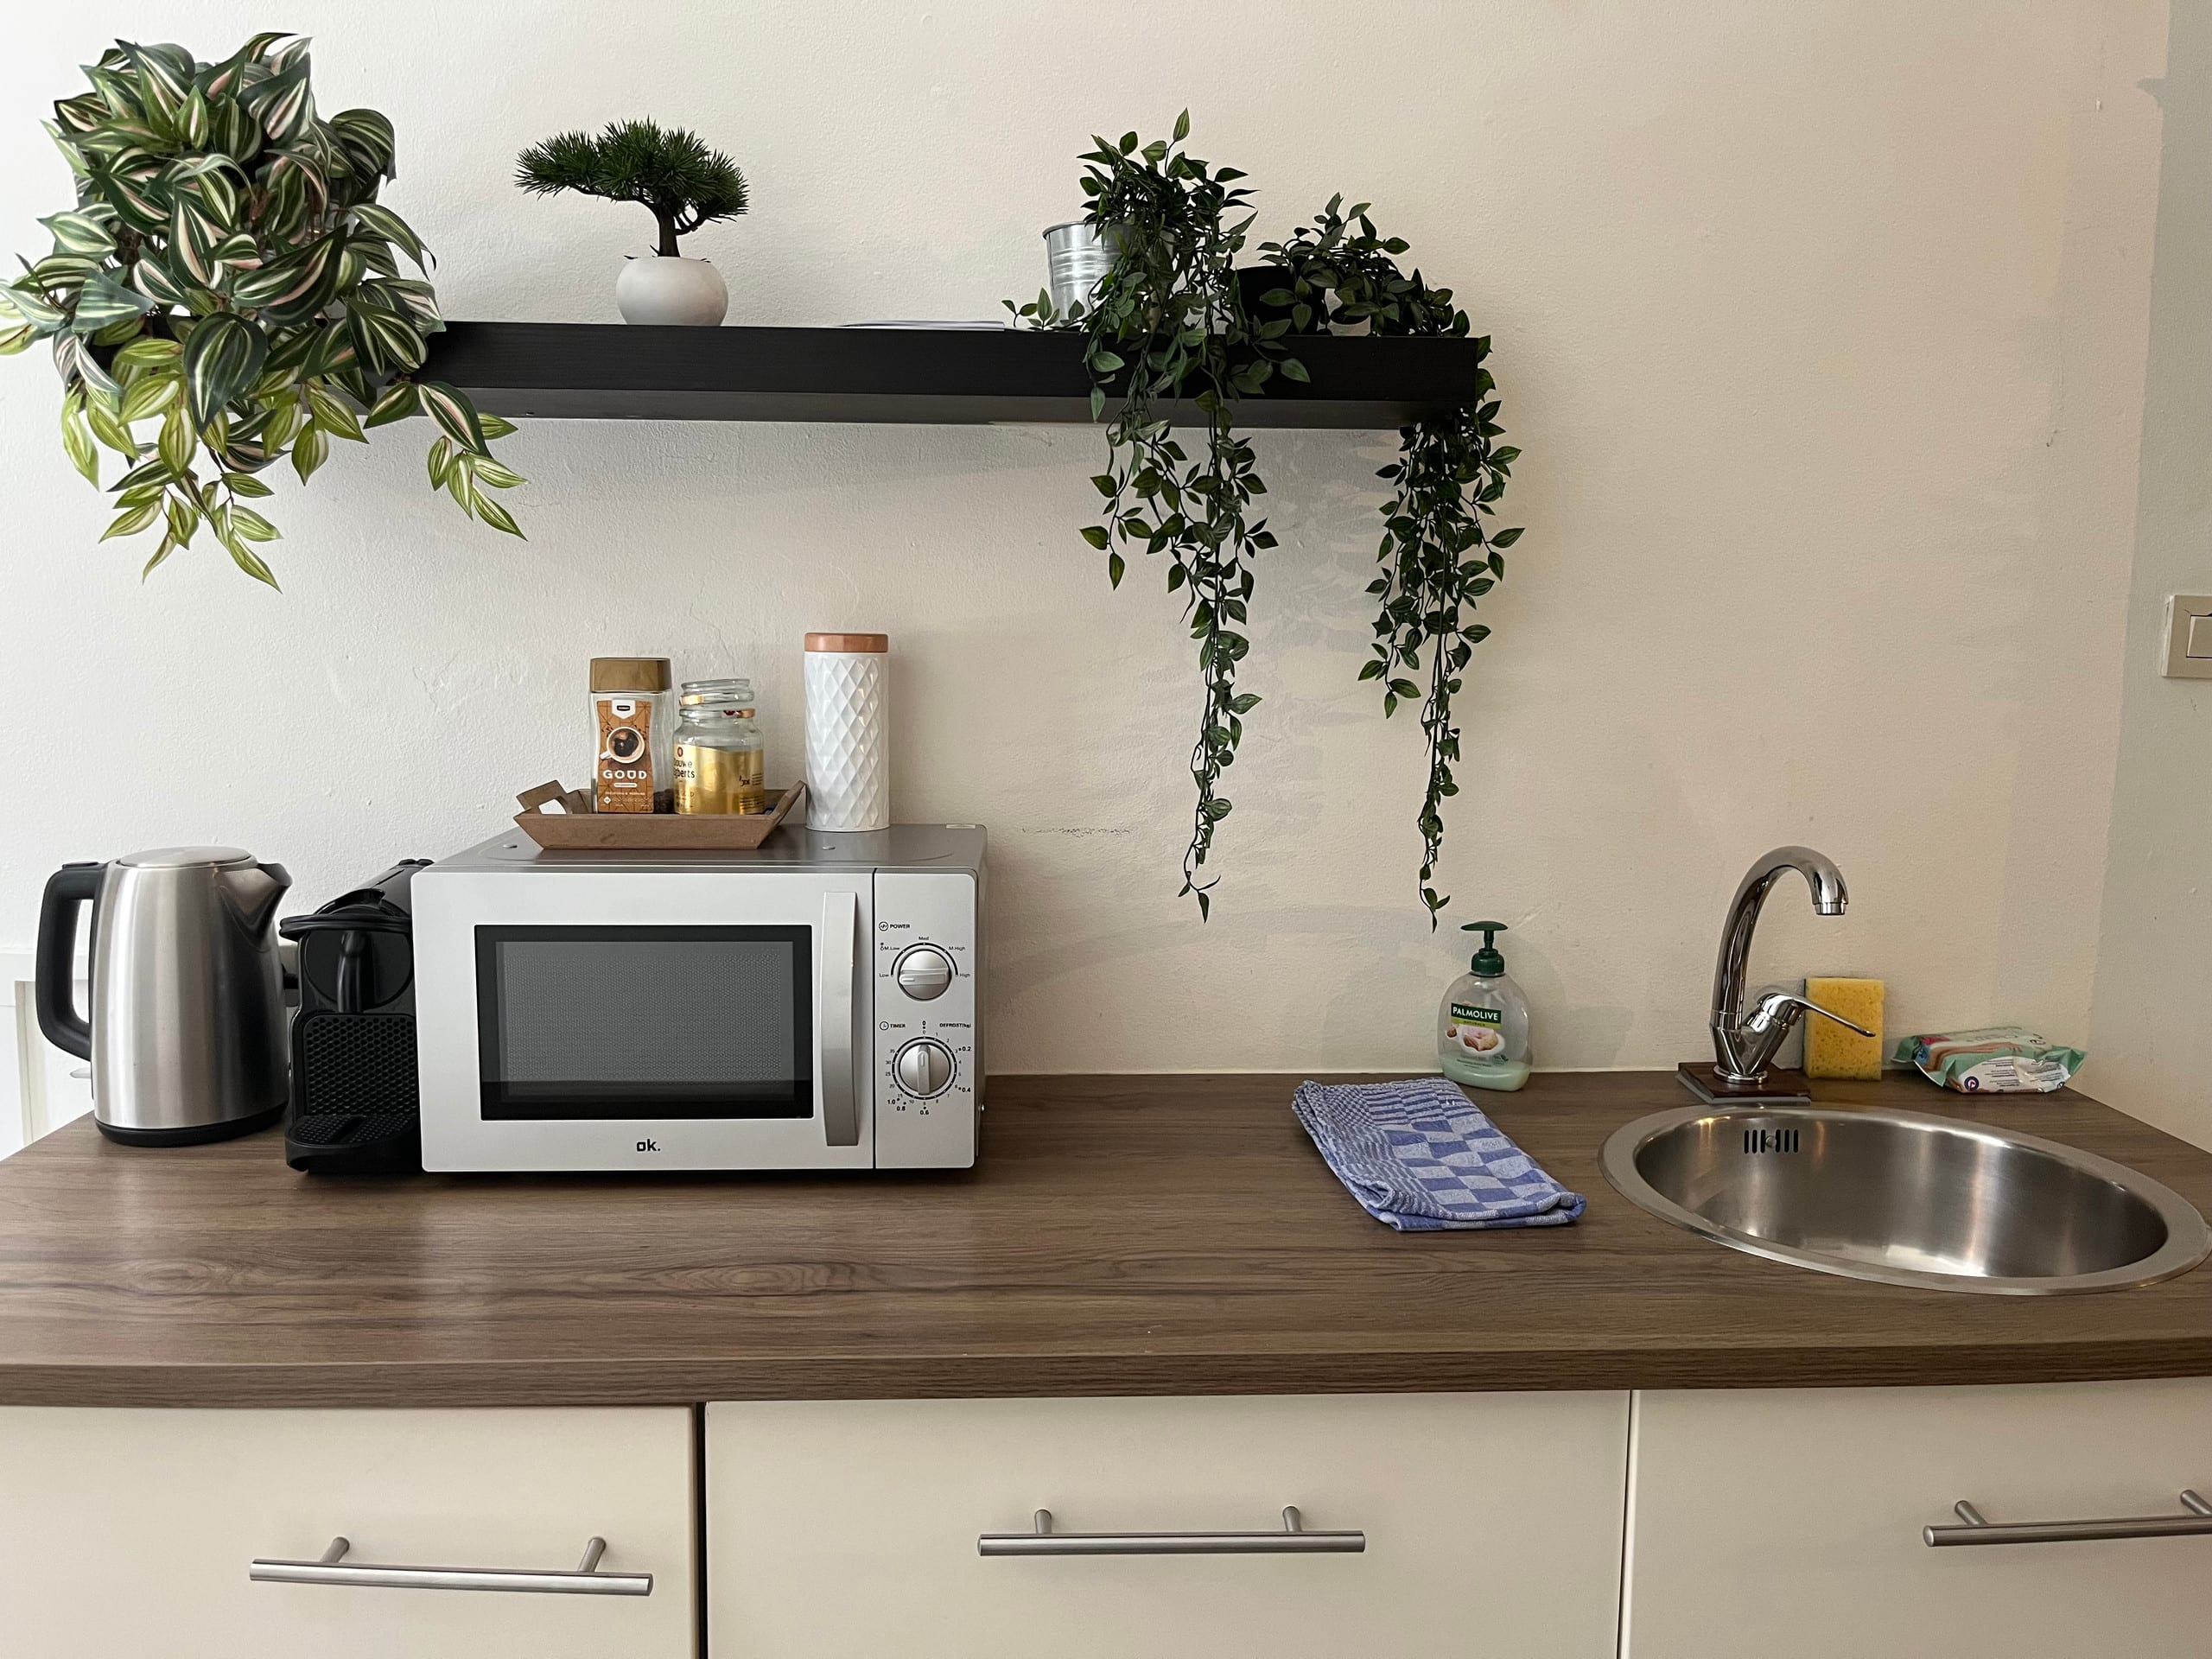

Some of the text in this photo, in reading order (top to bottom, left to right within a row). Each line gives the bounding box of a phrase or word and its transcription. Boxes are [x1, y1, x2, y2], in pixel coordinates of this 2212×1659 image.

[603, 770, 647, 779] GOUD
[1452, 1007, 1498, 1020] PALMOLIVE
[636, 1138, 661, 1152] ok.
